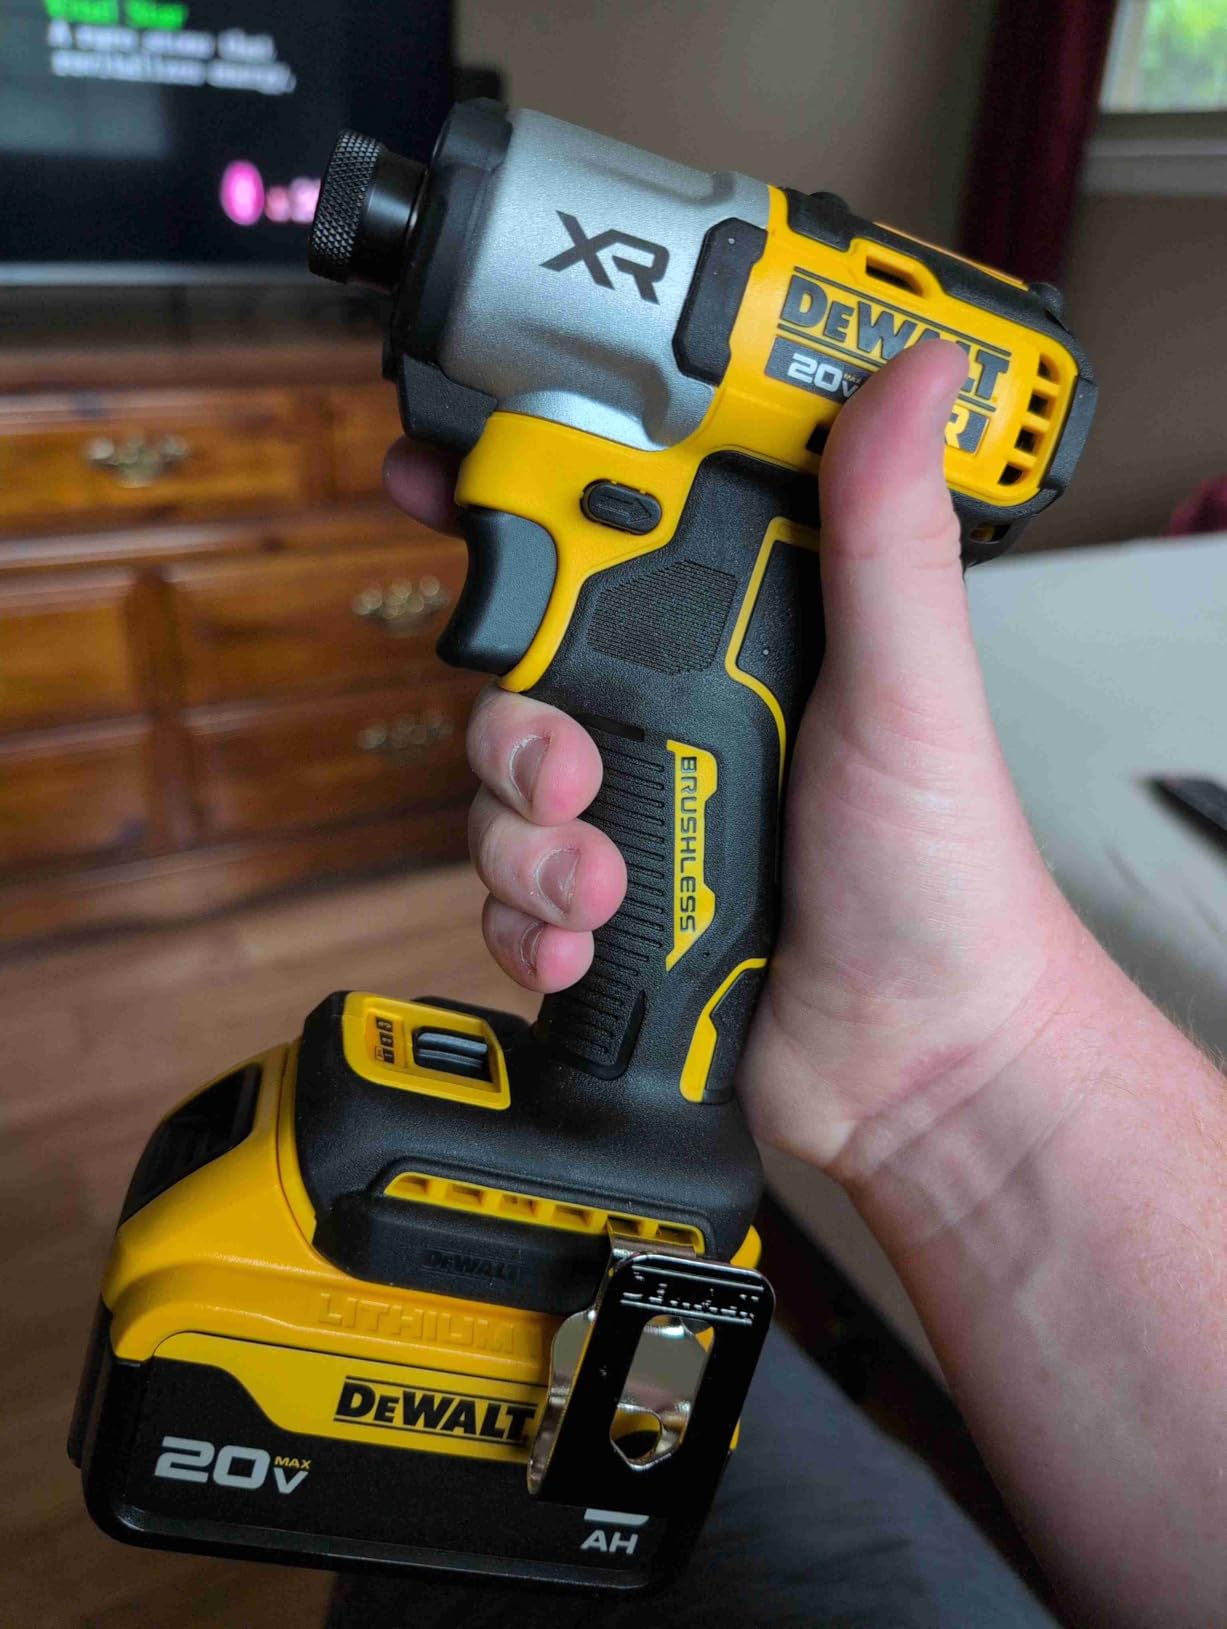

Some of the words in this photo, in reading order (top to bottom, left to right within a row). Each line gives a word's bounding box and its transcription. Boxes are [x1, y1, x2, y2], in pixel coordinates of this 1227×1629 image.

[539, 210, 670, 305] XR
[680, 756, 697, 932] BRUSHLESS
[318, 1292, 515, 1354] LITHIUM
[335, 1381, 536, 1441] DEWALT
[274, 1455, 312, 1470] MAX
[580, 1529, 639, 1555] AH
